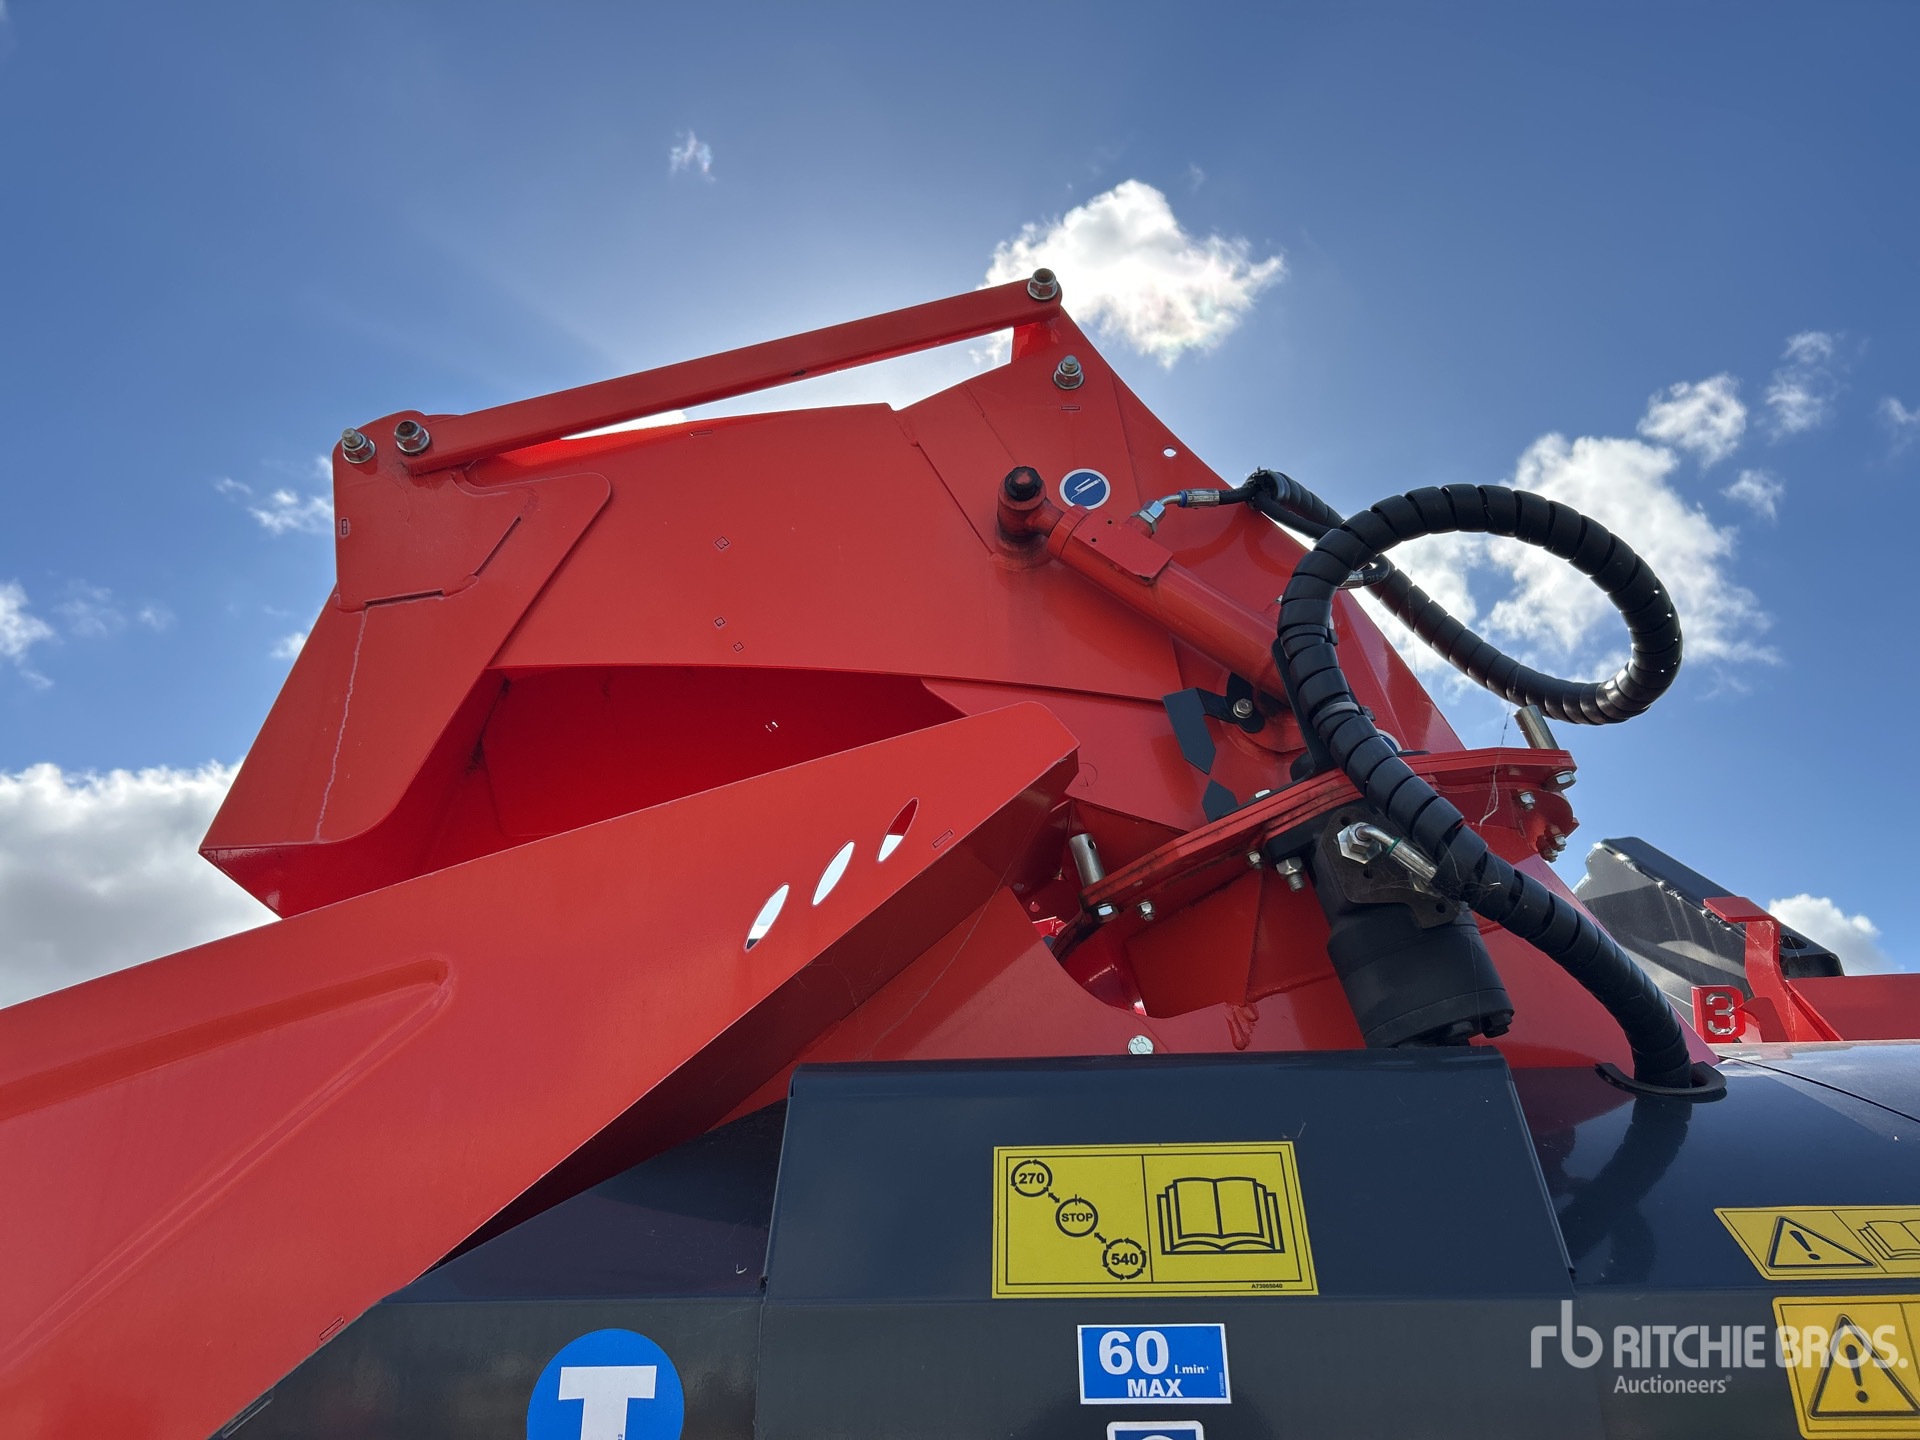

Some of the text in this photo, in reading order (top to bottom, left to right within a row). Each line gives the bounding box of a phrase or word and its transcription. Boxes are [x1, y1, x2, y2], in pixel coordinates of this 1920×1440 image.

[1018, 1173, 1045, 1185] 270
[1061, 1213, 1093, 1223] STOP
[1111, 1253, 1139, 1266] 540
[1098, 1330, 1169, 1375] 60
[1127, 1378, 1183, 1398] MAX
